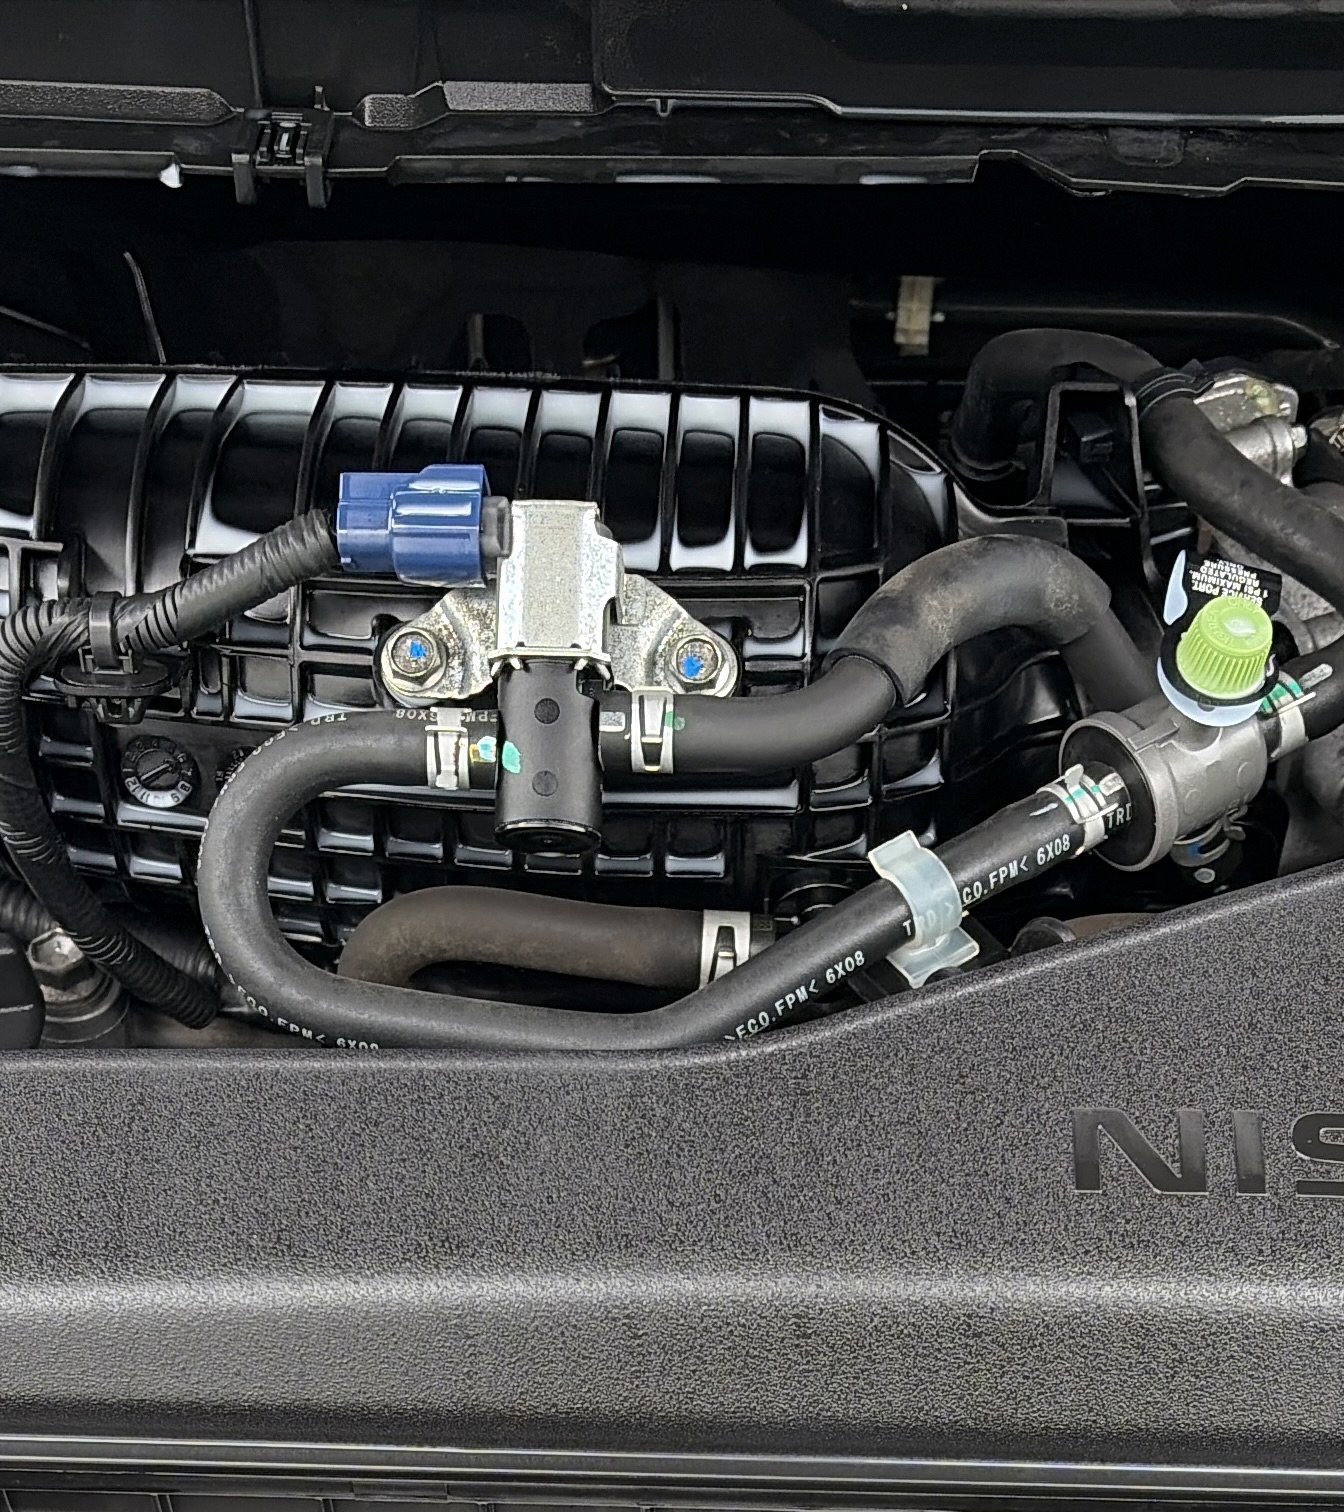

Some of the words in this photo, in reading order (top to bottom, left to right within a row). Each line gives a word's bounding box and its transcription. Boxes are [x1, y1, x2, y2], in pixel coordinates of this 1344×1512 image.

[1199, 565, 1260, 588] REGULATED
[1244, 583, 1261, 597] PSI
[1036, 833, 1072, 866] 6X08
[825, 950, 866, 984] 6X08
